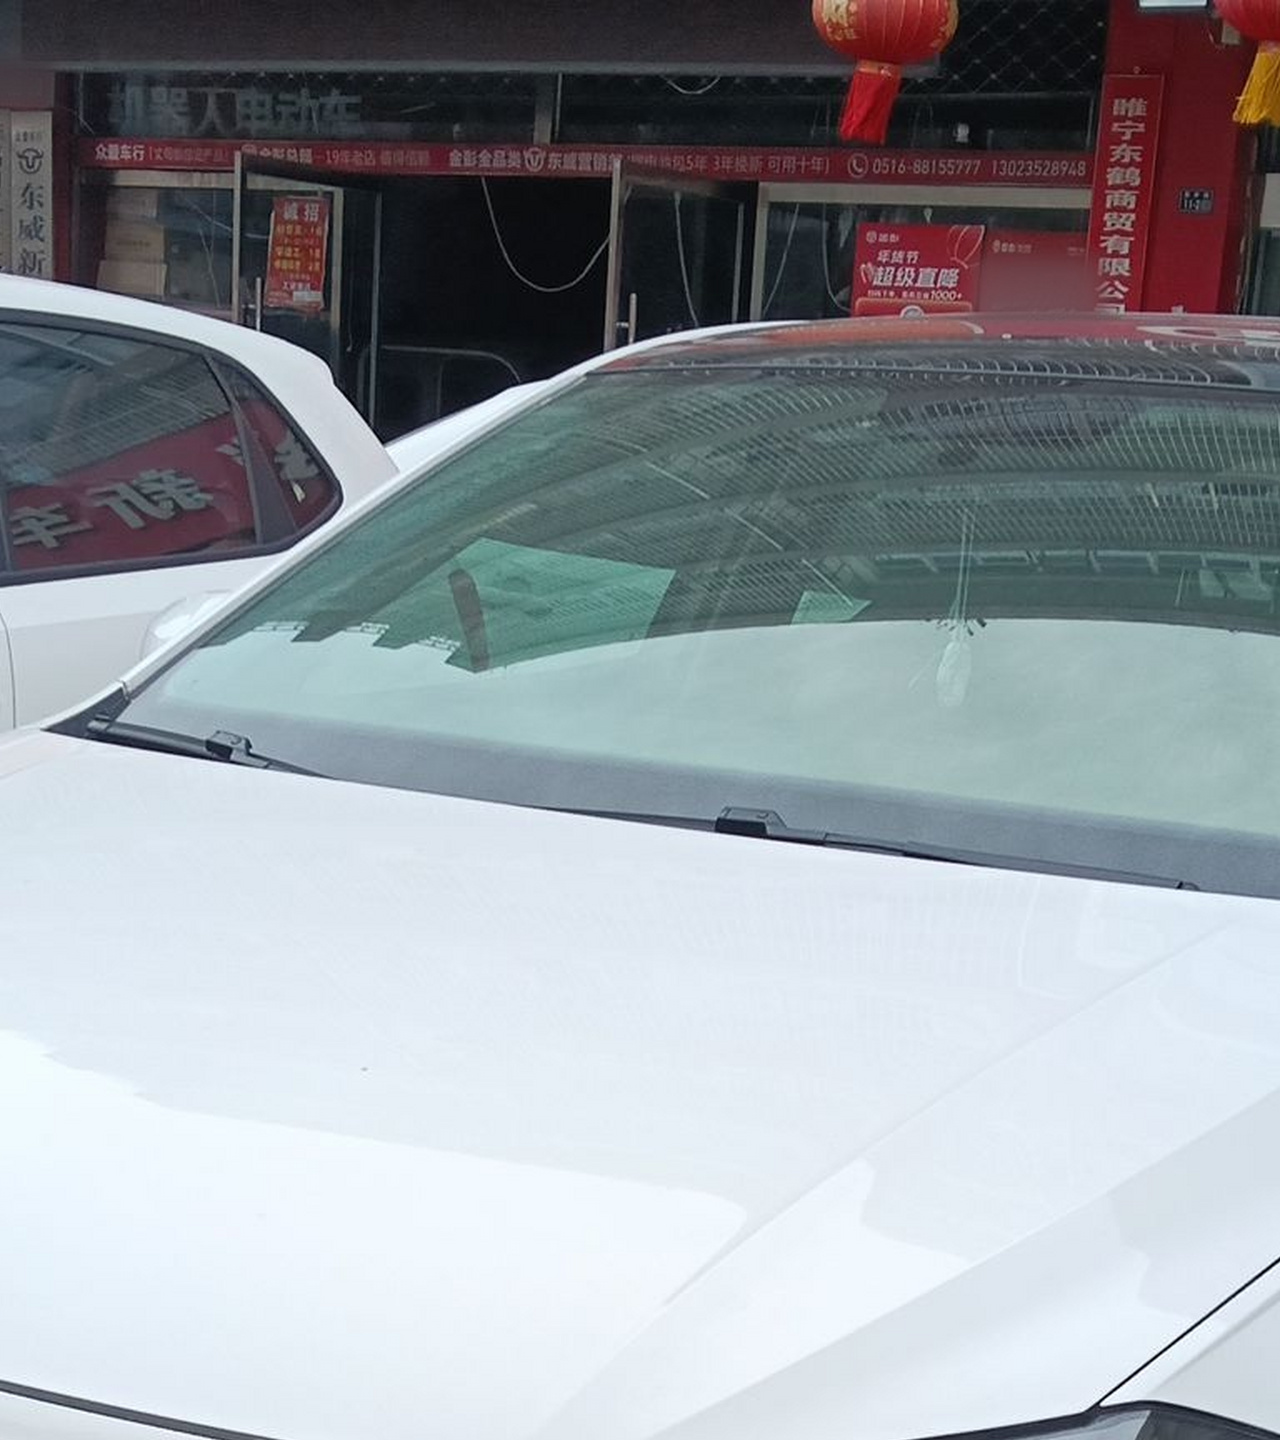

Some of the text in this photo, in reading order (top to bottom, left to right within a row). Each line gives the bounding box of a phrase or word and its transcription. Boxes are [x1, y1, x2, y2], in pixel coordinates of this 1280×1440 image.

[872, 158, 1087, 177] 0516-88155777 13023528948
[876, 249, 921, 264] 年货节
[872, 266, 960, 289] 超级直降
